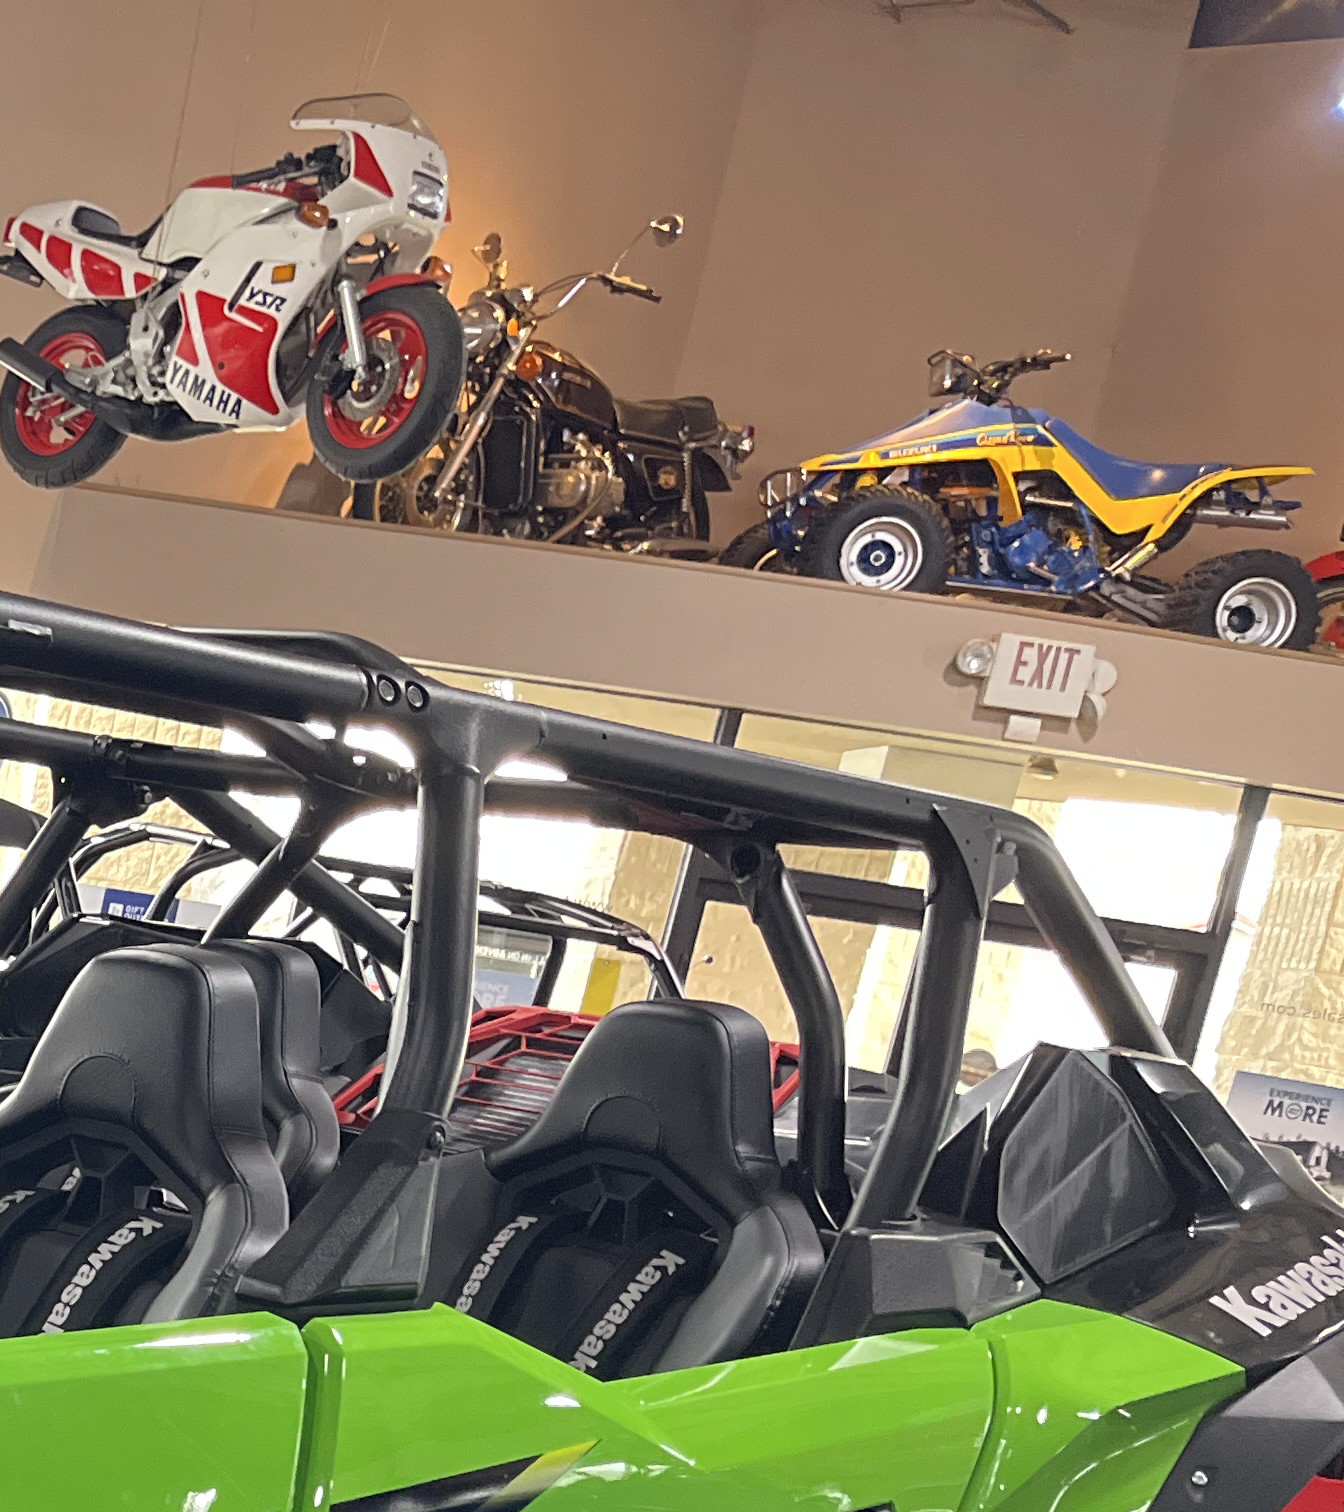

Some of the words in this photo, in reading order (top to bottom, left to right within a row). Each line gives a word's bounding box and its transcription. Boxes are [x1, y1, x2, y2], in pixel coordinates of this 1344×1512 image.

[246, 286, 287, 312] YSR
[169, 361, 243, 420] YAMAHA
[1009, 641, 1081, 692] EXIT
[1263, 1099, 1330, 1125] MORE
[41, 1215, 164, 1334] Kawasa
[455, 1214, 538, 1314] Kawasa
[1208, 1228, 1344, 1337] Kawas
[568, 1249, 686, 1373] Kawasak
